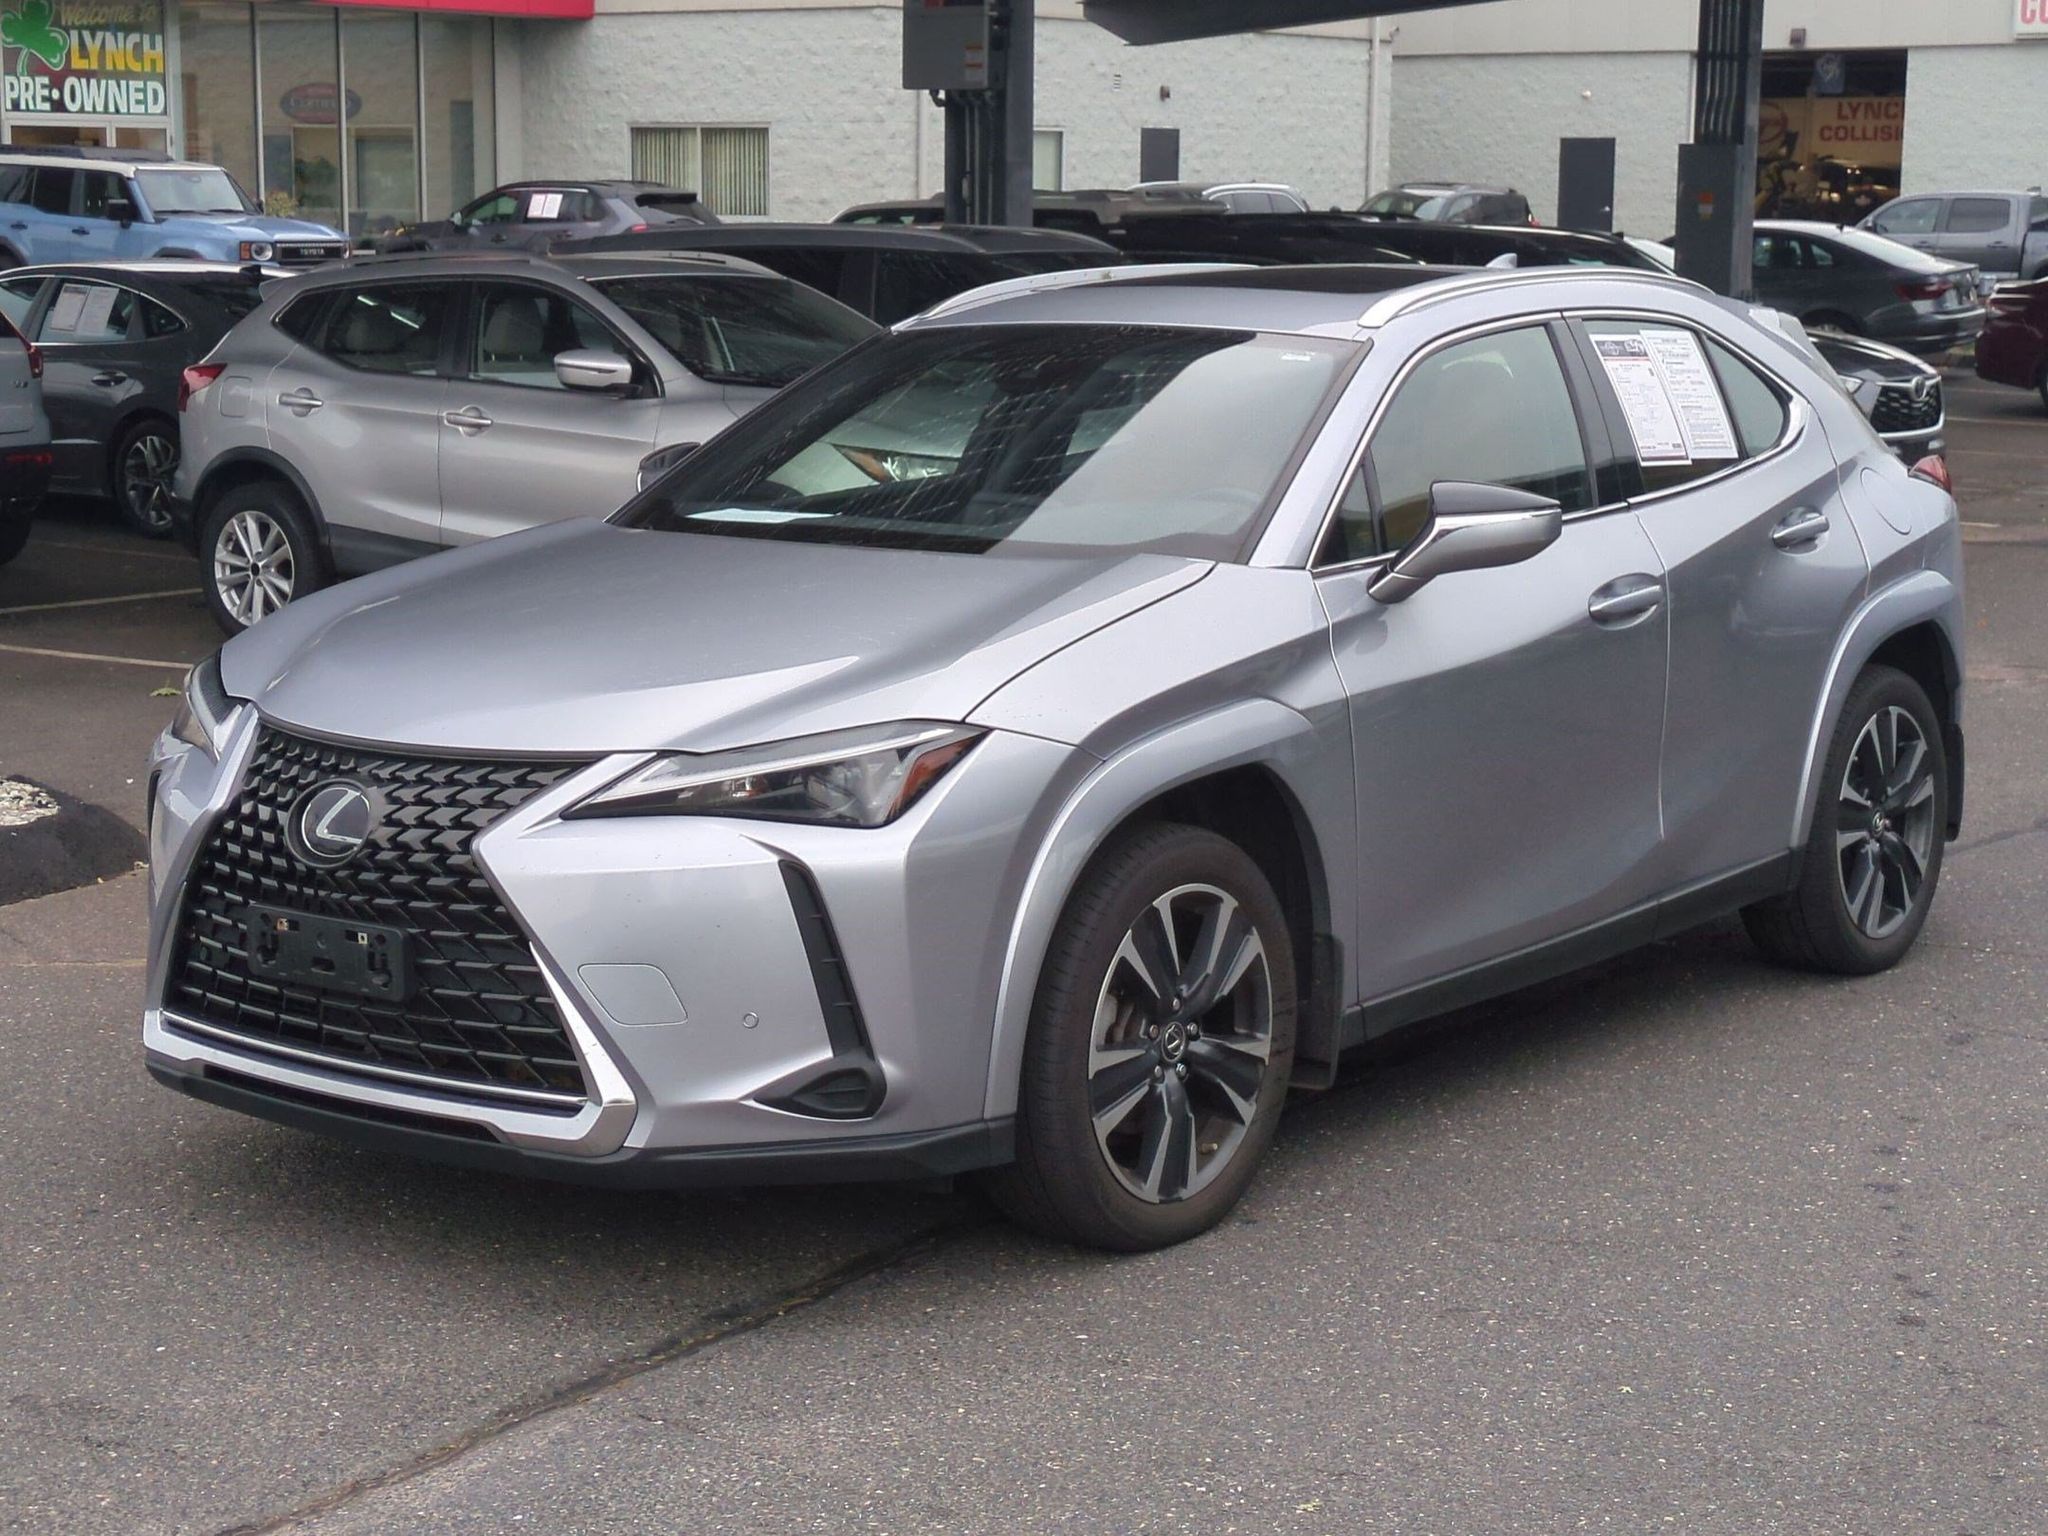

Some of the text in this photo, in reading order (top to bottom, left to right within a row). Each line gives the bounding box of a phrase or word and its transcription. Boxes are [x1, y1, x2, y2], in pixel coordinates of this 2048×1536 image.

[69, 29, 164, 73] LYNCH
[1837, 101, 1904, 120] LYNC
[1819, 125, 1903, 142] COLLISI
